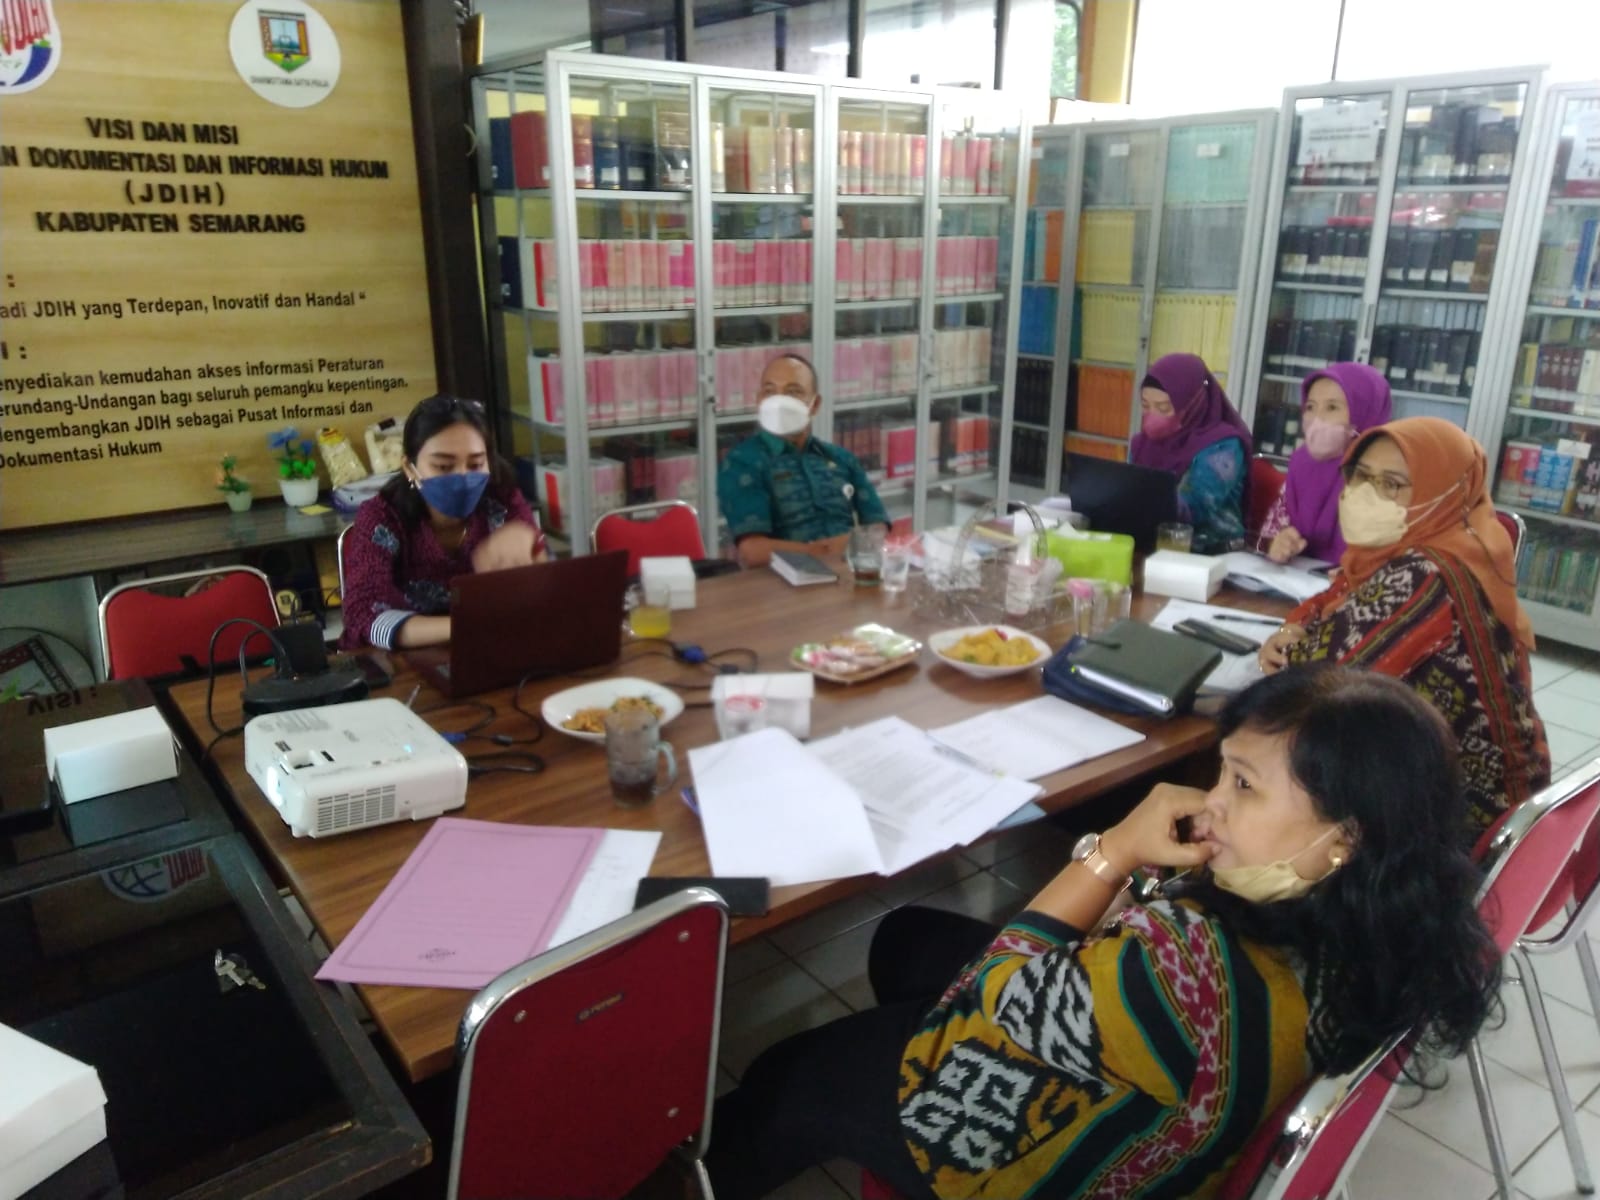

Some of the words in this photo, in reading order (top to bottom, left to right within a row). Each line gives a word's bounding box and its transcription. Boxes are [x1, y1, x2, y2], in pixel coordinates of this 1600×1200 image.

[86, 117, 134, 140] VISI
[142, 121, 187, 142] DAN
[192, 124, 238, 145] MISI
[0, 146, 18, 167] N
[28, 147, 177, 173] DOKUMENTASI
[183, 153, 223, 174] DAN
[229, 155, 324, 177] INFORMASI
[330, 158, 389, 179] HUKUM
[35, 211, 179, 233] KABUPATEN
[188, 213, 305, 233] SEMARANG
[33, 300, 76, 318] JDIH
[82, 301, 122, 320] yang
[126, 296, 208, 316] Terdepan,
[212, 293, 270, 310] Inovatif
[275, 292, 301, 308] dan
[305, 291, 355, 307] Handal
[0, 371, 94, 395] nyediakan
[99, 366, 192, 386] kemudahan
[197, 363, 241, 380] akses
[246, 358, 314, 376] informasi
[318, 357, 384, 373] Peraturan
[0, 392, 156, 417] rundang-Undangan
[160, 390, 192, 407] bagi
[196, 384, 250, 402] seluruh
[254, 380, 324, 401] pemangku
[327, 376, 408, 395] kepentingan.
[135, 414, 171, 432] JDIH
[176, 409, 233, 429] sebagai
[238, 406, 277, 423] Pusat
[282, 402, 345, 419] Informasi
[350, 399, 373, 414] dan
[108, 440, 162, 458] Hukum
